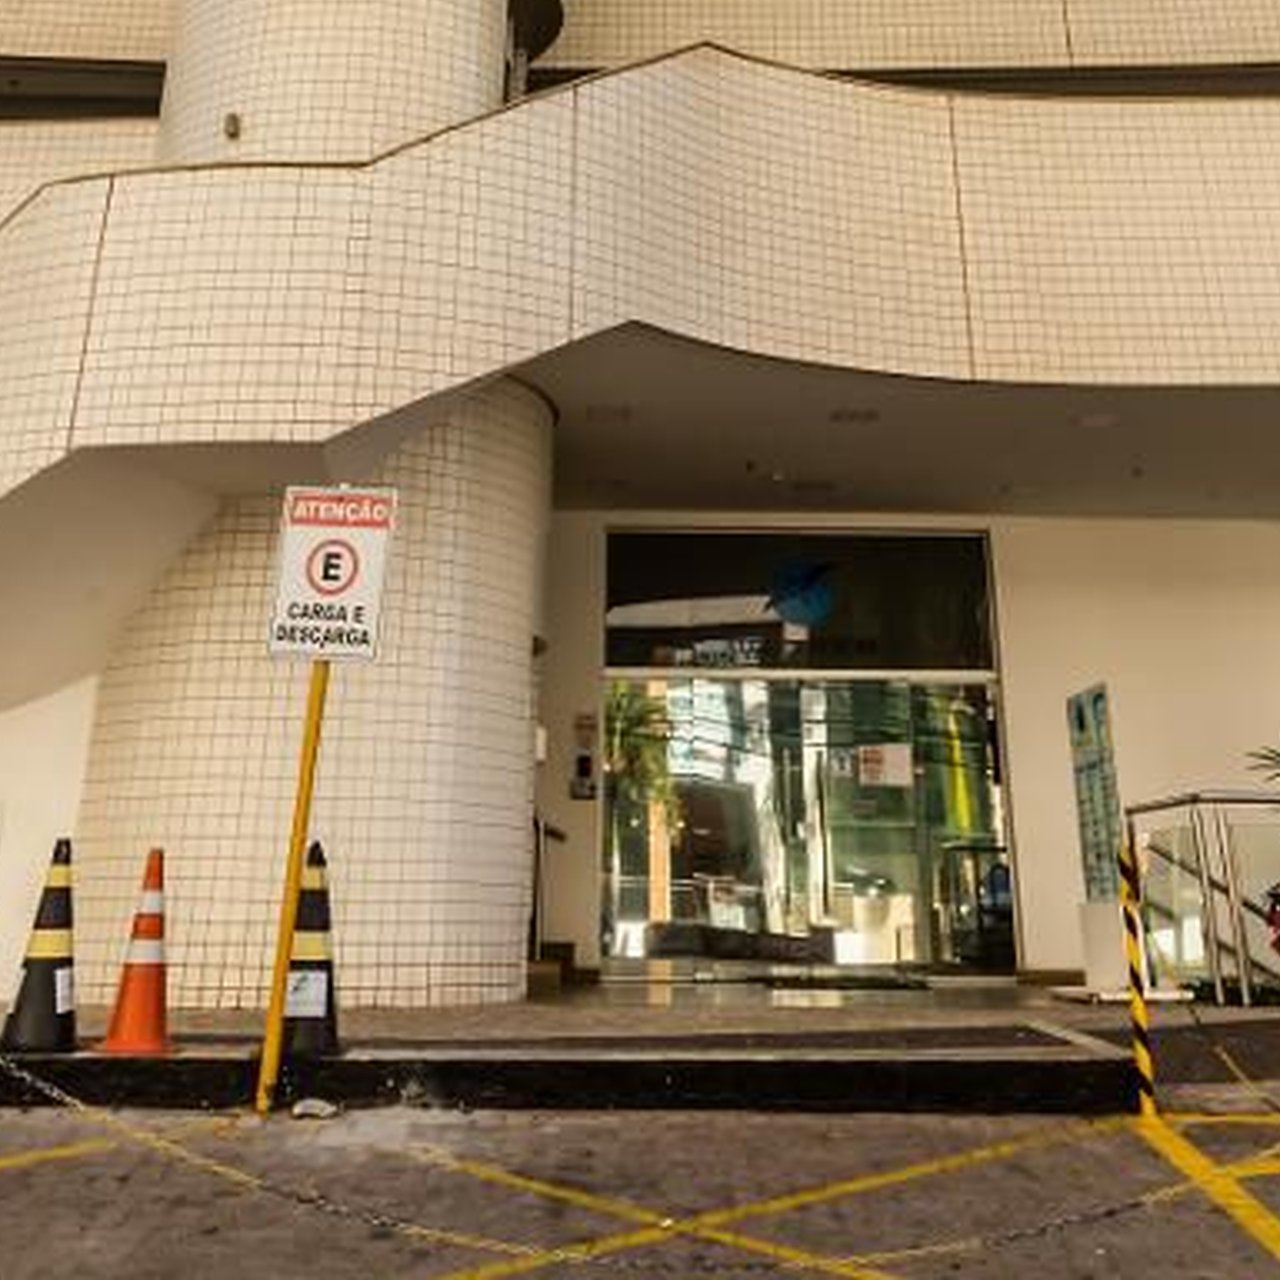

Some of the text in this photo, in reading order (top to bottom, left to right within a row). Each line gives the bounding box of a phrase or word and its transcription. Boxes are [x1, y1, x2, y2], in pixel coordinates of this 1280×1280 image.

[293, 500, 387, 521] ATENÇÃO
[322, 552, 342, 581] E
[288, 602, 366, 624] CARGA E
